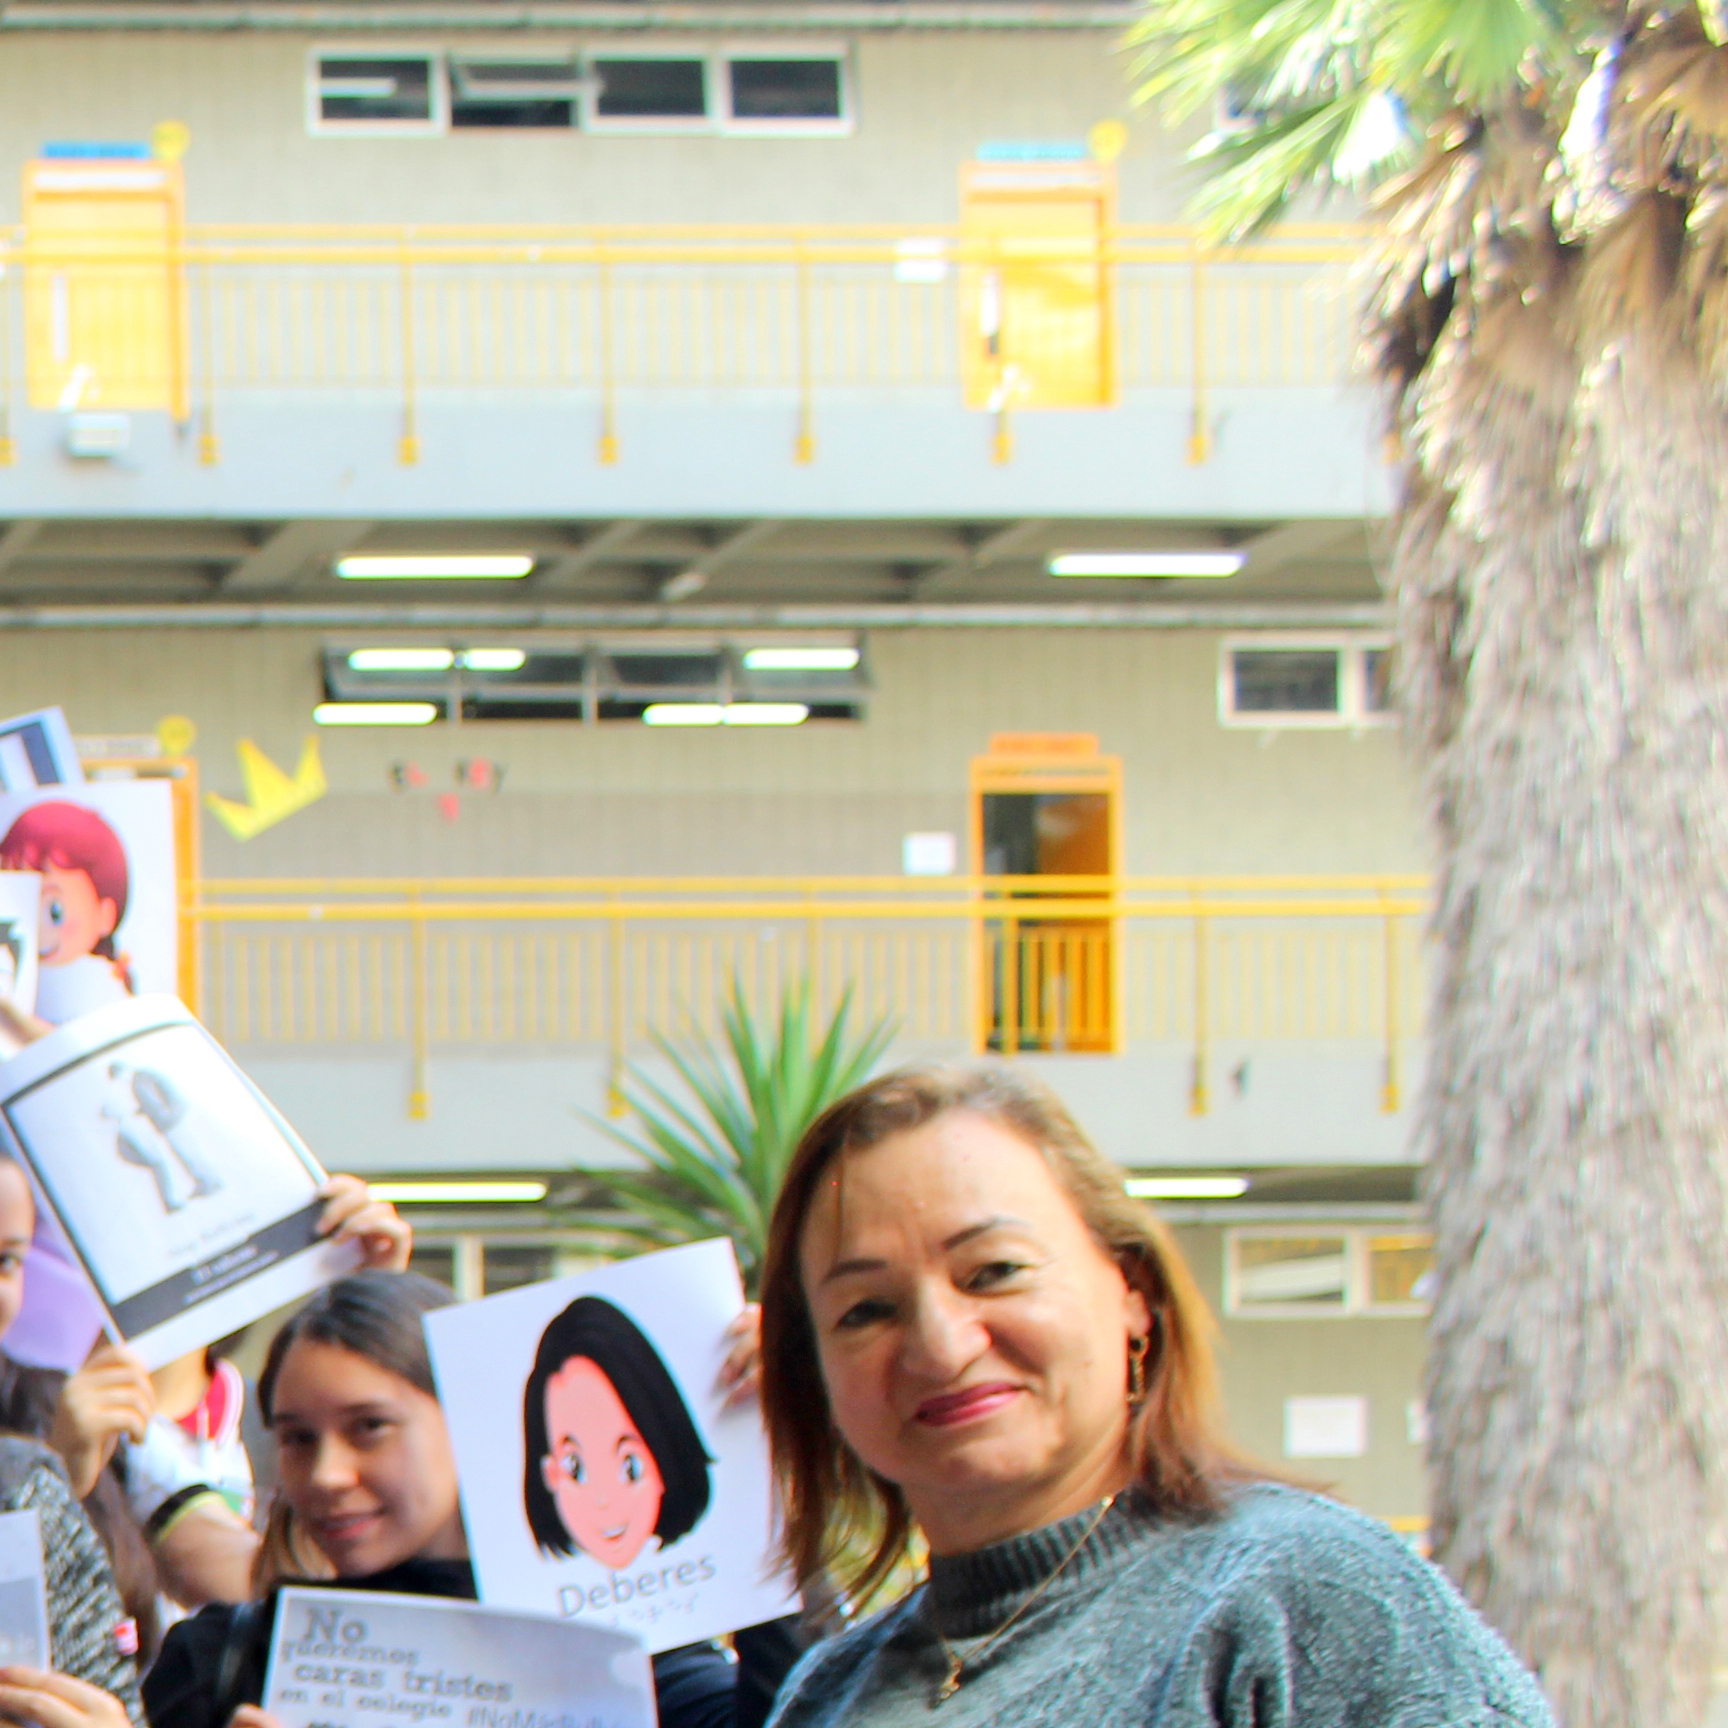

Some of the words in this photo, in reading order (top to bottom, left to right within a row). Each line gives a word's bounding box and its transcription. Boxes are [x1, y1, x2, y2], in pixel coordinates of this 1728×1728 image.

[557, 1554, 717, 1618] Deberes
[301, 1607, 367, 1644] No
[294, 1662, 385, 1689] caras
[404, 1669, 513, 1702] tristes
